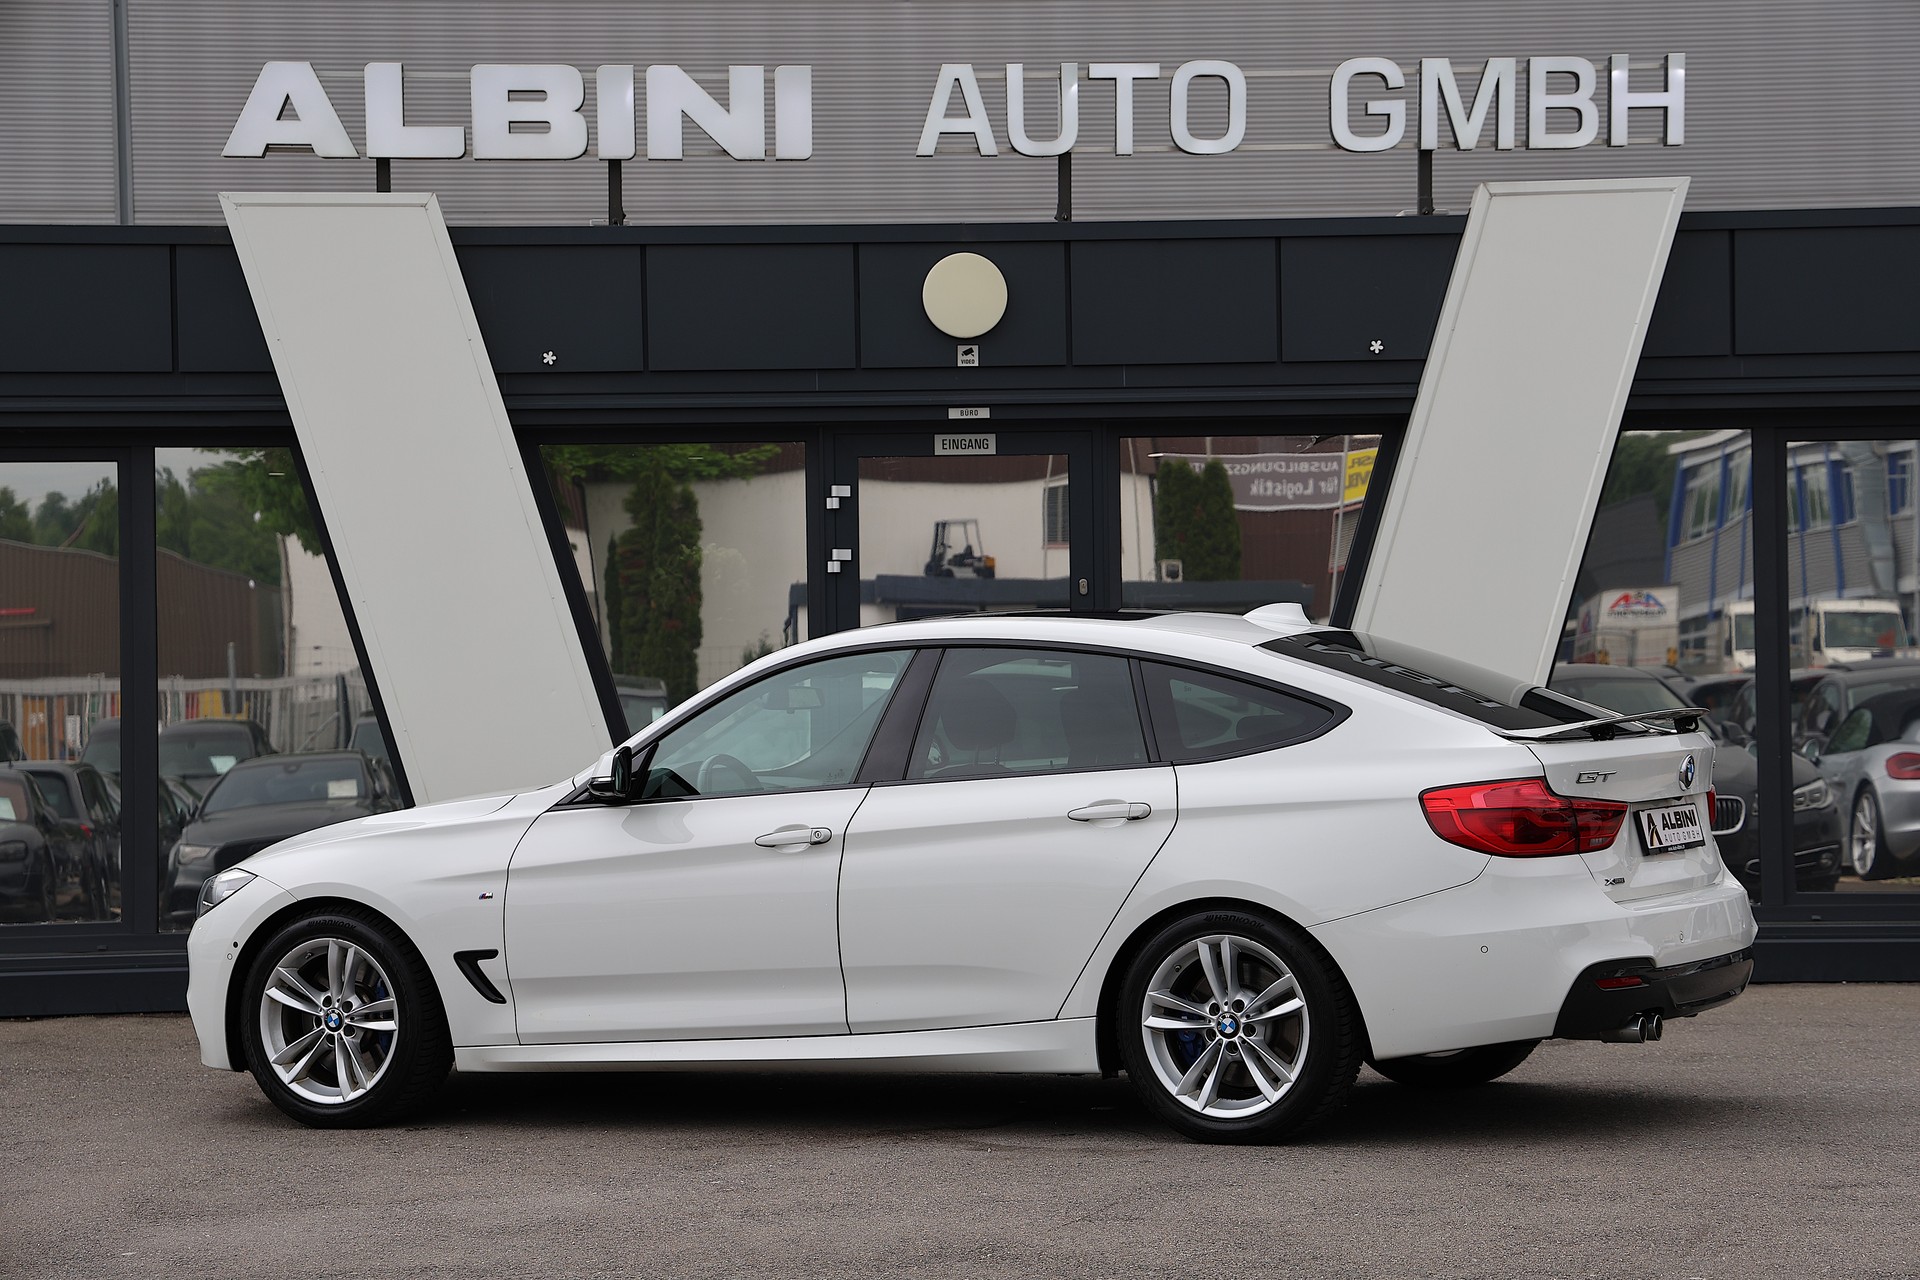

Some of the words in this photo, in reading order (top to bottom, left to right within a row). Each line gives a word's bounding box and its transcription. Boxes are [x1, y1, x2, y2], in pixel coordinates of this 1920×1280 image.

[221, 61, 813, 161] ALBINI
[916, 60, 1247, 158] AUTO
[1330, 53, 1686, 153] GMBH
[960, 409, 979, 417] BÜRO
[941, 438, 989, 450] EINGANG
[1576, 770, 1617, 784] GT
[1661, 809, 1698, 831] ALBINI
[1664, 832, 1681, 842] AUTO
[1682, 830, 1701, 840] GMBH
